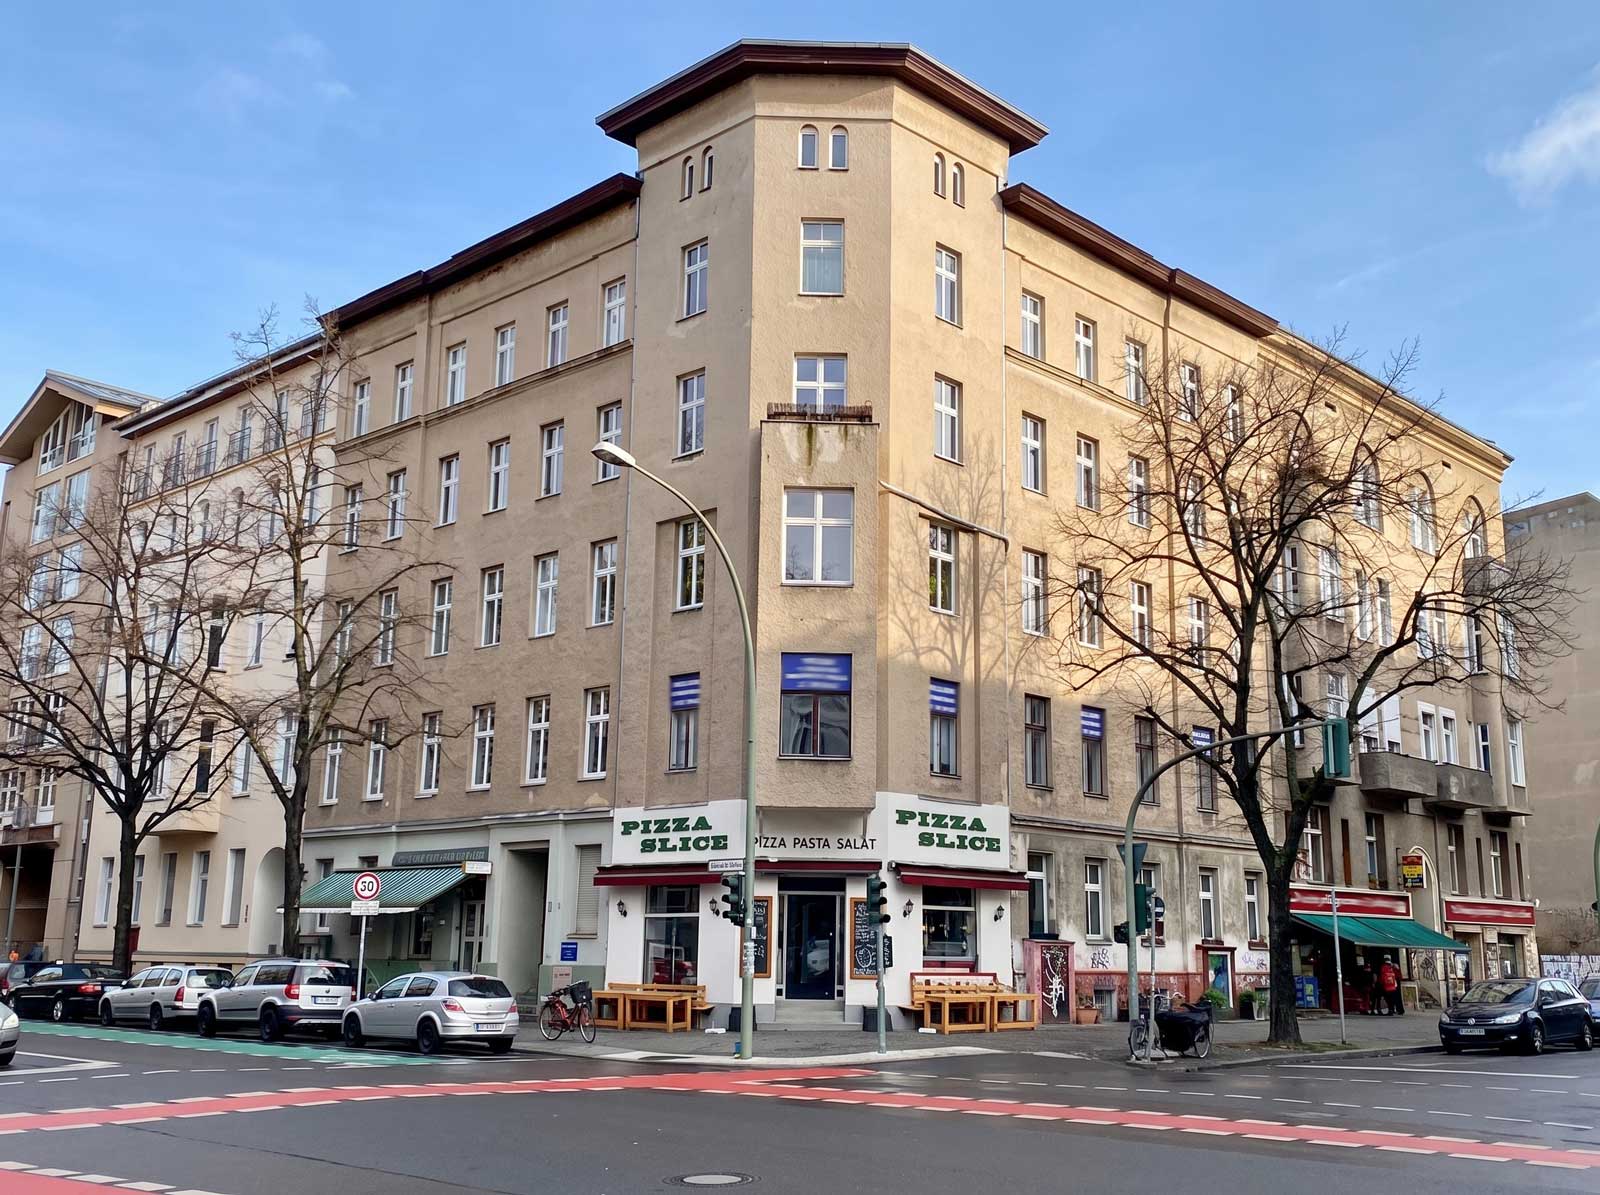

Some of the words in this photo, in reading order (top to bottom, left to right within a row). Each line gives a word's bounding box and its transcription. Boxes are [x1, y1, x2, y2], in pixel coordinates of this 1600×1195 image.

[621, 816, 712, 835] PIZZA
[896, 809, 987, 832] PIZZA
[640, 835, 728, 853] SLICE
[793, 837, 831, 849] PASTA
[837, 838, 877, 850] SALAT
[918, 832, 1001, 852] SLICE
